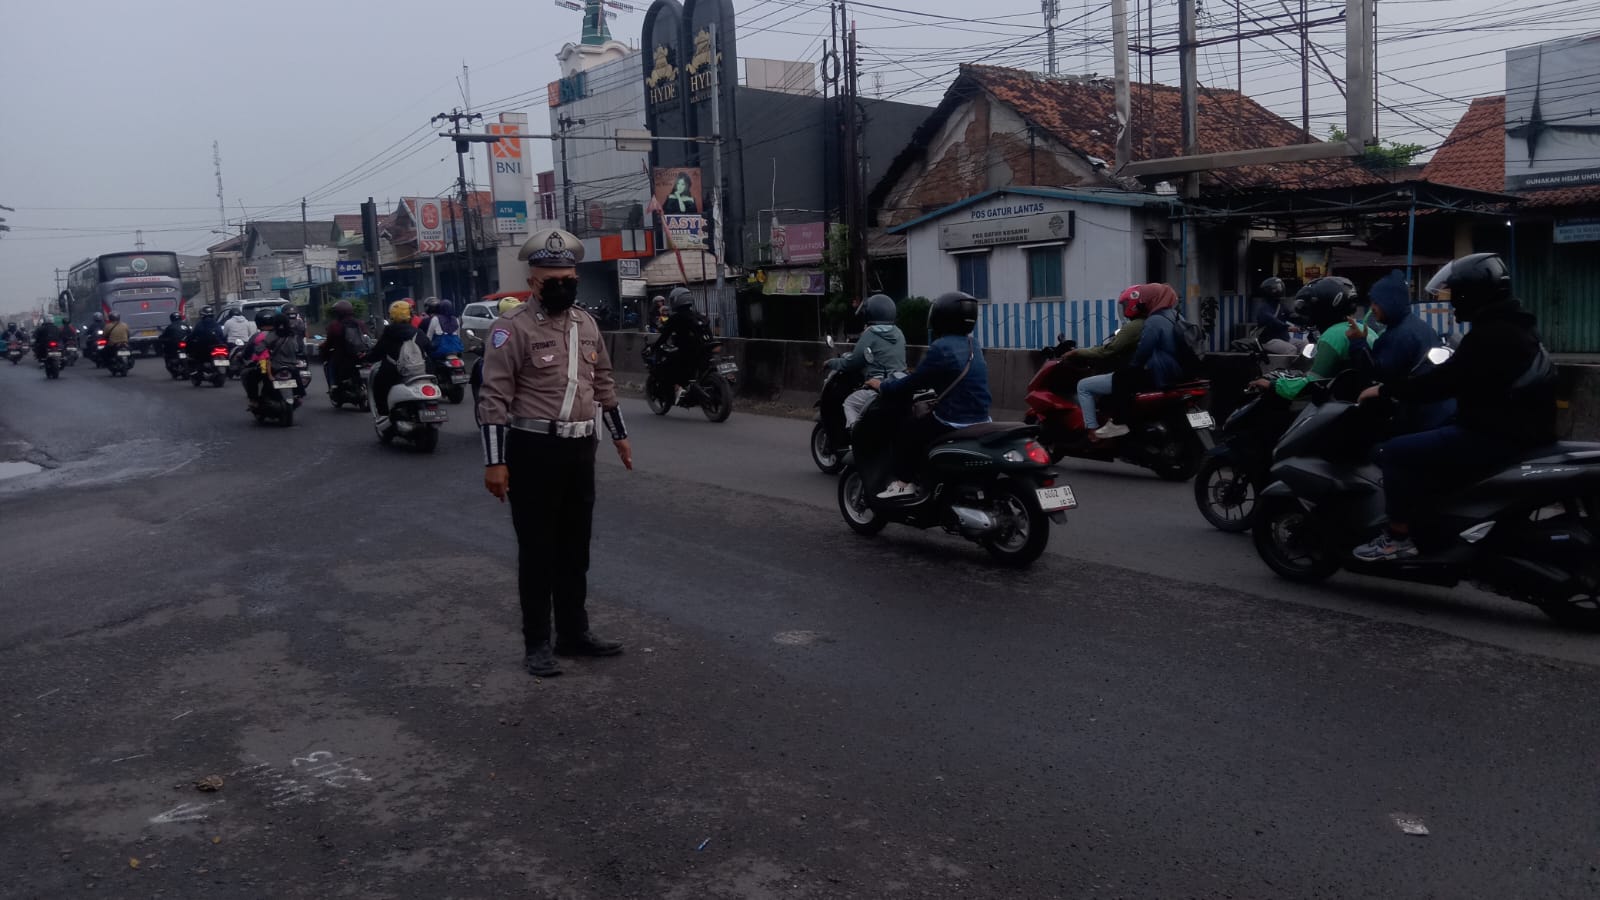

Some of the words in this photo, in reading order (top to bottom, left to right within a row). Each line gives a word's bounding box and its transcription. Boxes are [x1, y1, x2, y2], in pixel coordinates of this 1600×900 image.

[690, 71, 720, 92] HYD
[650, 84, 675, 104] HYDE
[496, 162, 520, 173] BNI
[1526, 177, 1560, 185] GUNAKAN
[971, 210, 985, 219] POS
[987, 207, 1012, 217] GATUR
[1014, 203, 1044, 214] LANTAS
